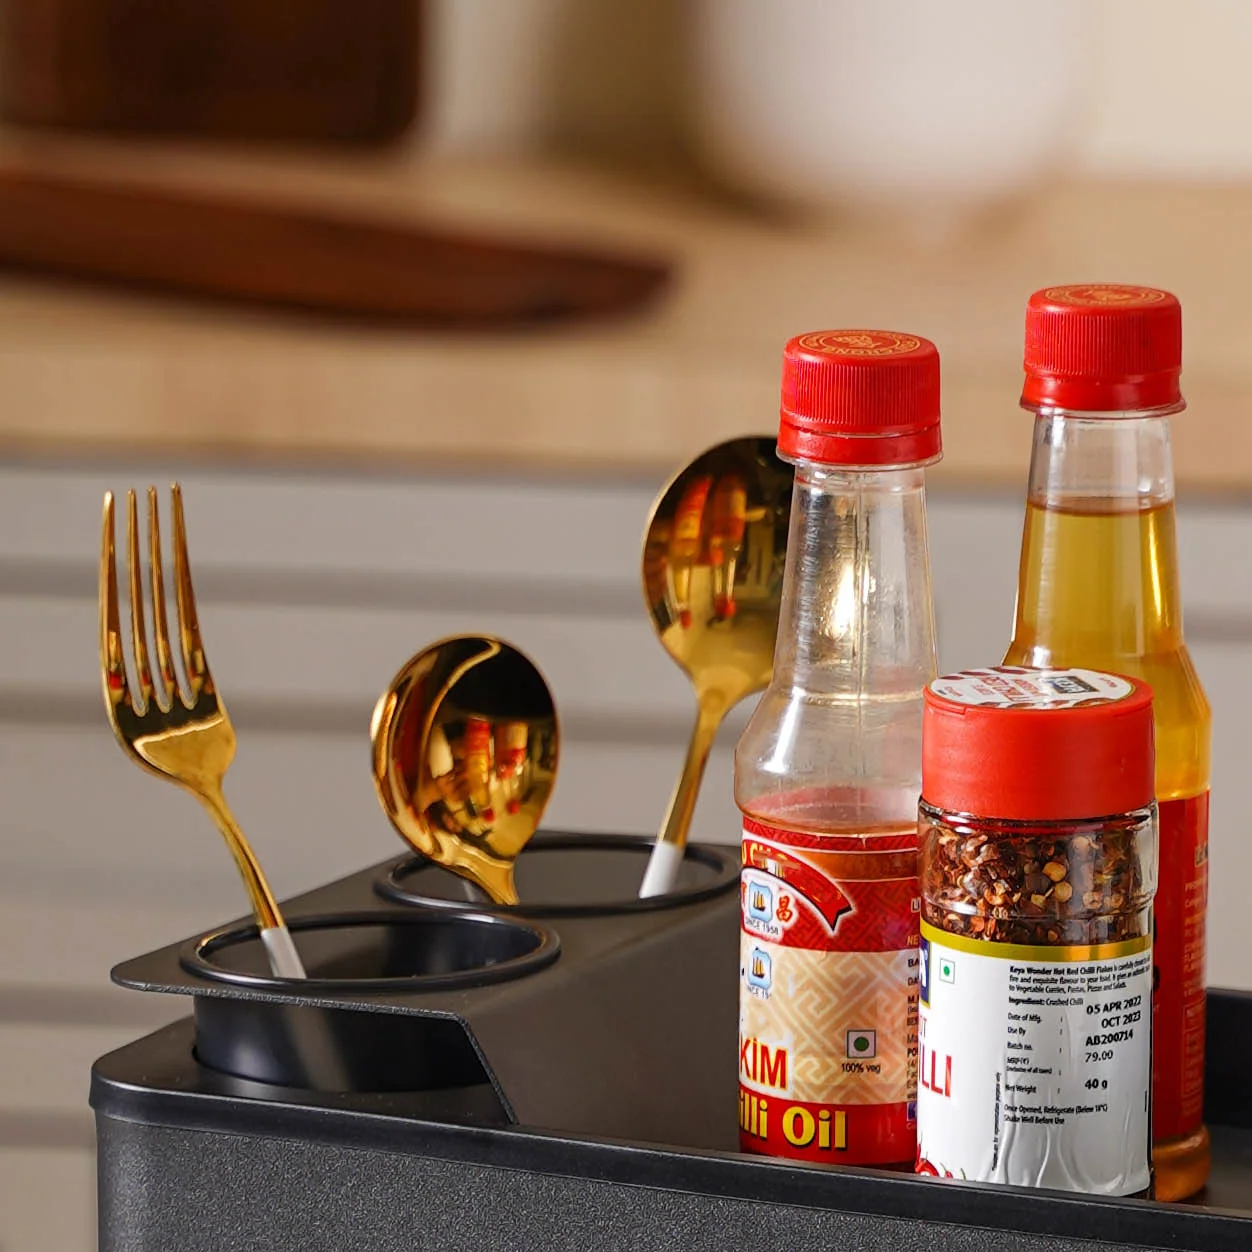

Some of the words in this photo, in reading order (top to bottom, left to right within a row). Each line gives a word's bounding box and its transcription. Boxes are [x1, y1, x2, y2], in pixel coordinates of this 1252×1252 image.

[1027, 967, 1052, 975] Wonder
[1054, 967, 1065, 975] Hot
[1067, 967, 1078, 975] Red
[1080, 966, 1096, 974] Chilli
[1016, 985, 1044, 994] Vegetable
[1086, 1005, 1100, 1015] 05
[1103, 1000, 1122, 1013] APR
[1124, 996, 1142, 1008] 2022
[1101, 1017, 1120, 1028] OCT
[1123, 1010, 1141, 1023] 2023
[1086, 1029, 1133, 1046] AB200714
[1085, 1050, 1114, 1063] 79.00
[841, 1062, 864, 1073] 100%
[867, 1064, 880, 1074] veg
[1016, 1084, 1036, 1094] Weight
[1085, 1078, 1099, 1089] 40
[1102, 1079, 1108, 1089] g
[1021, 1115, 1034, 1123] Well
[782, 1106, 846, 1148] Oil
